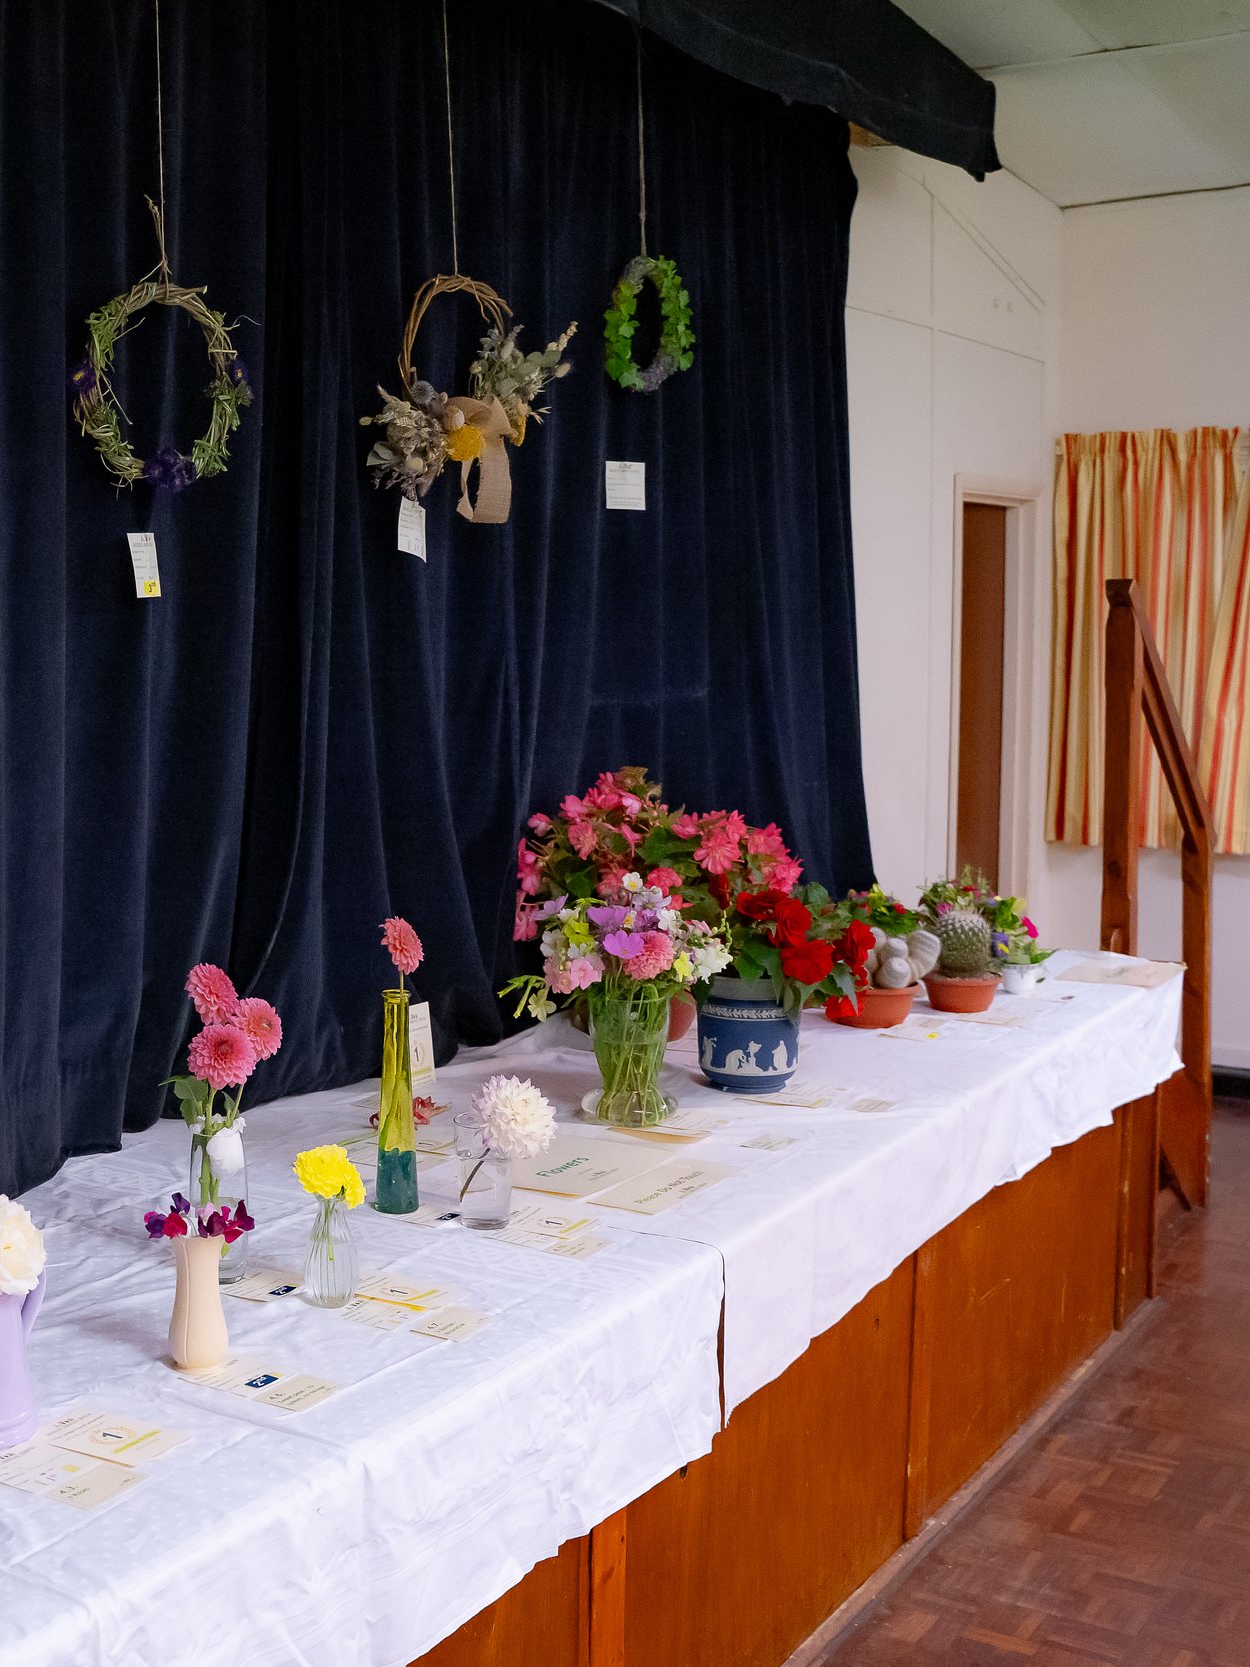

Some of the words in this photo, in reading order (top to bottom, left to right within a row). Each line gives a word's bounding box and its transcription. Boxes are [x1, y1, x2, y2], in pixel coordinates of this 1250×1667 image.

[413, 1046, 420, 1062] 1
[535, 1155, 590, 1178] Flowers
[634, 1189, 661, 1204] Please
[658, 1185, 673, 1195] Do
[669, 1178, 684, 1191] Not
[678, 1170, 705, 1185] Touch
[252, 1376, 267, 1387] 2nd
[101, 1431, 124, 1440] 1
